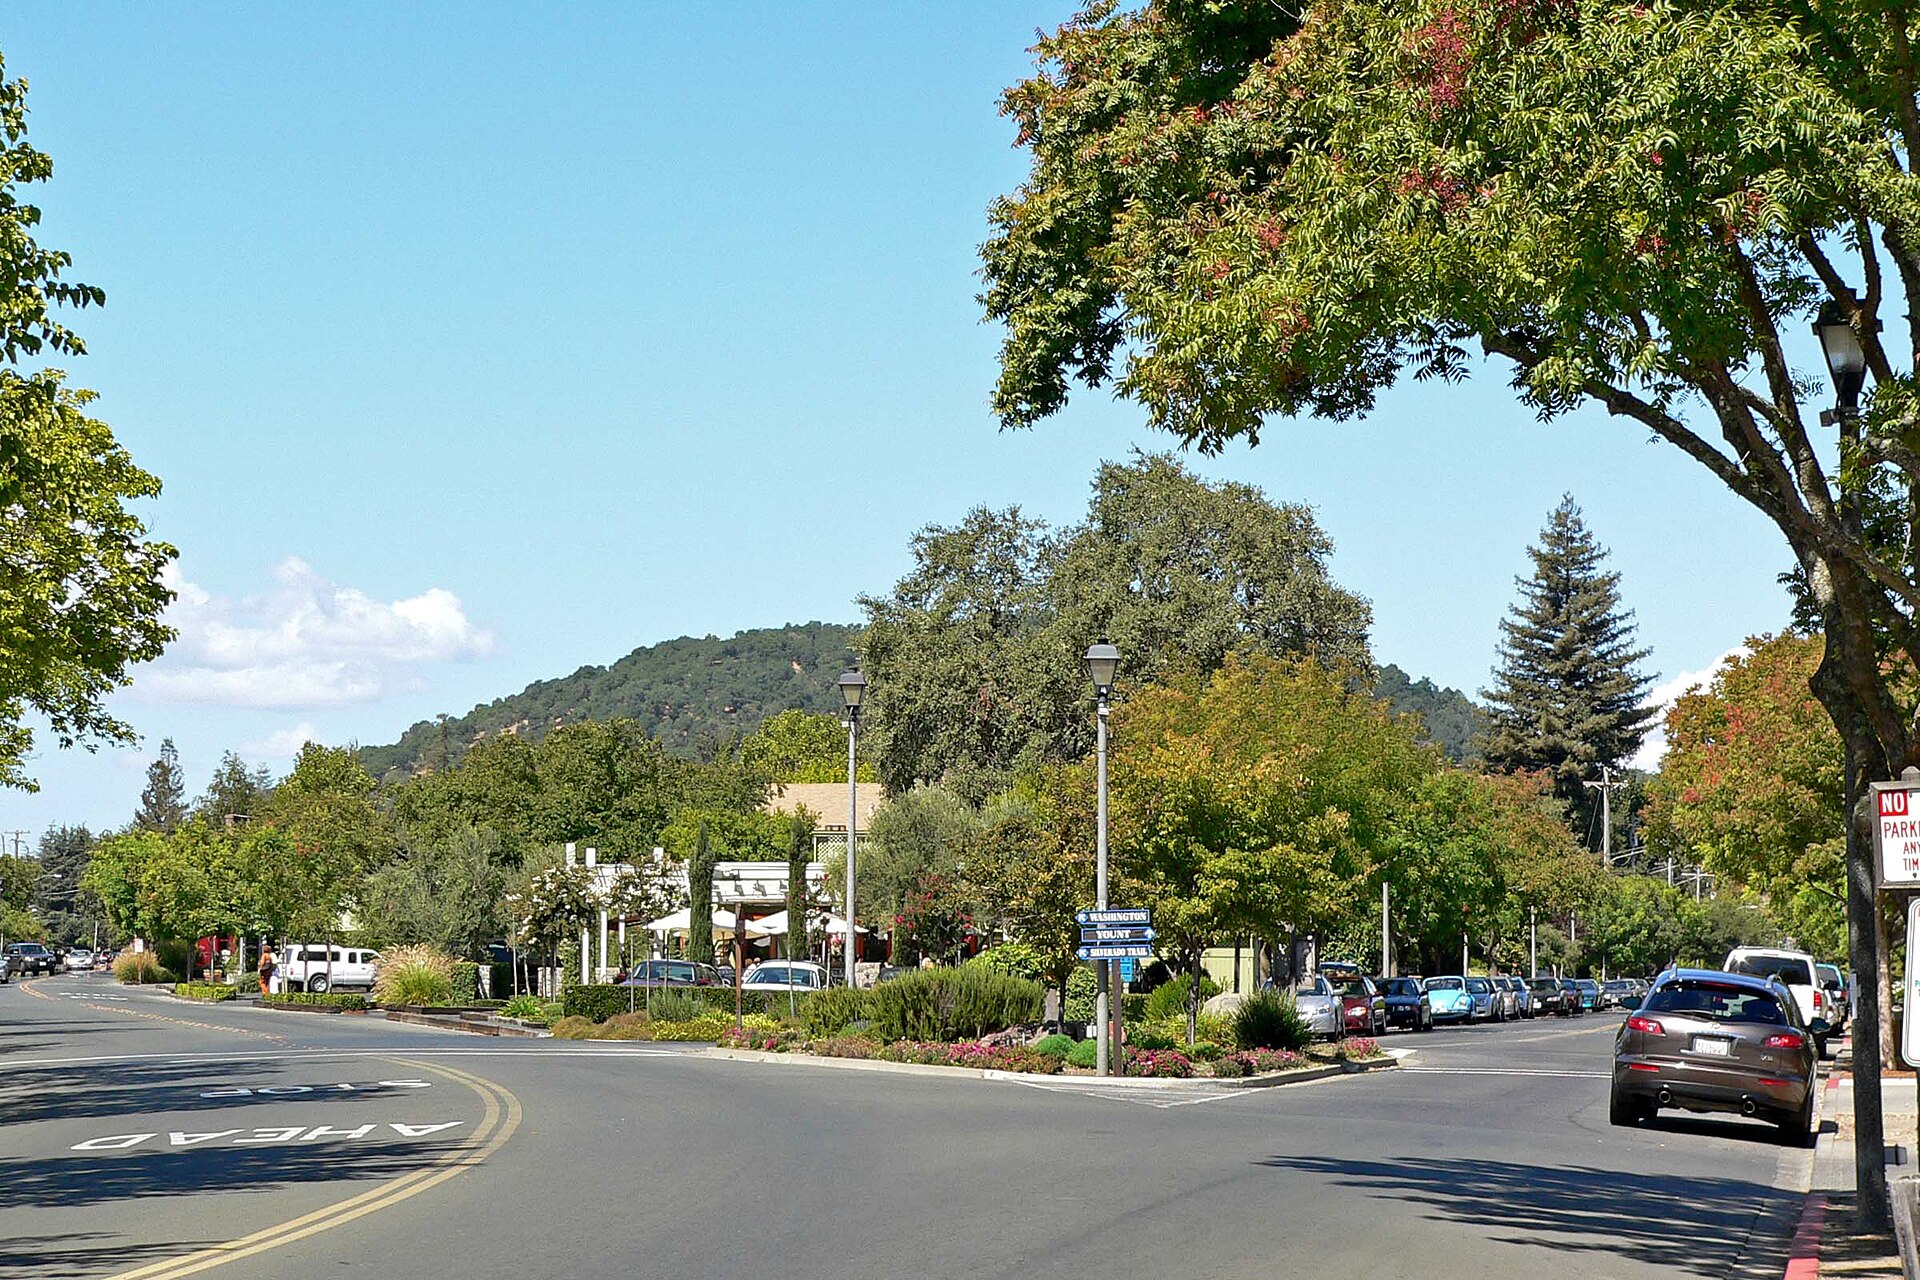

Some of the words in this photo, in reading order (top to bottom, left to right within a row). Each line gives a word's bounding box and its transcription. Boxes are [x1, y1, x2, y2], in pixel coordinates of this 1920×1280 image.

[1882, 793, 1905, 813] NO
[1089, 912, 1147, 922] WASHINGTON
[1096, 930, 1131, 939] YOUNT
[1090, 948, 1126, 957] SILVERADO
[1127, 947, 1147, 956] TRAIL
[200, 1079, 432, 1098] STOP
[70, 1121, 464, 1150] AHEAD
